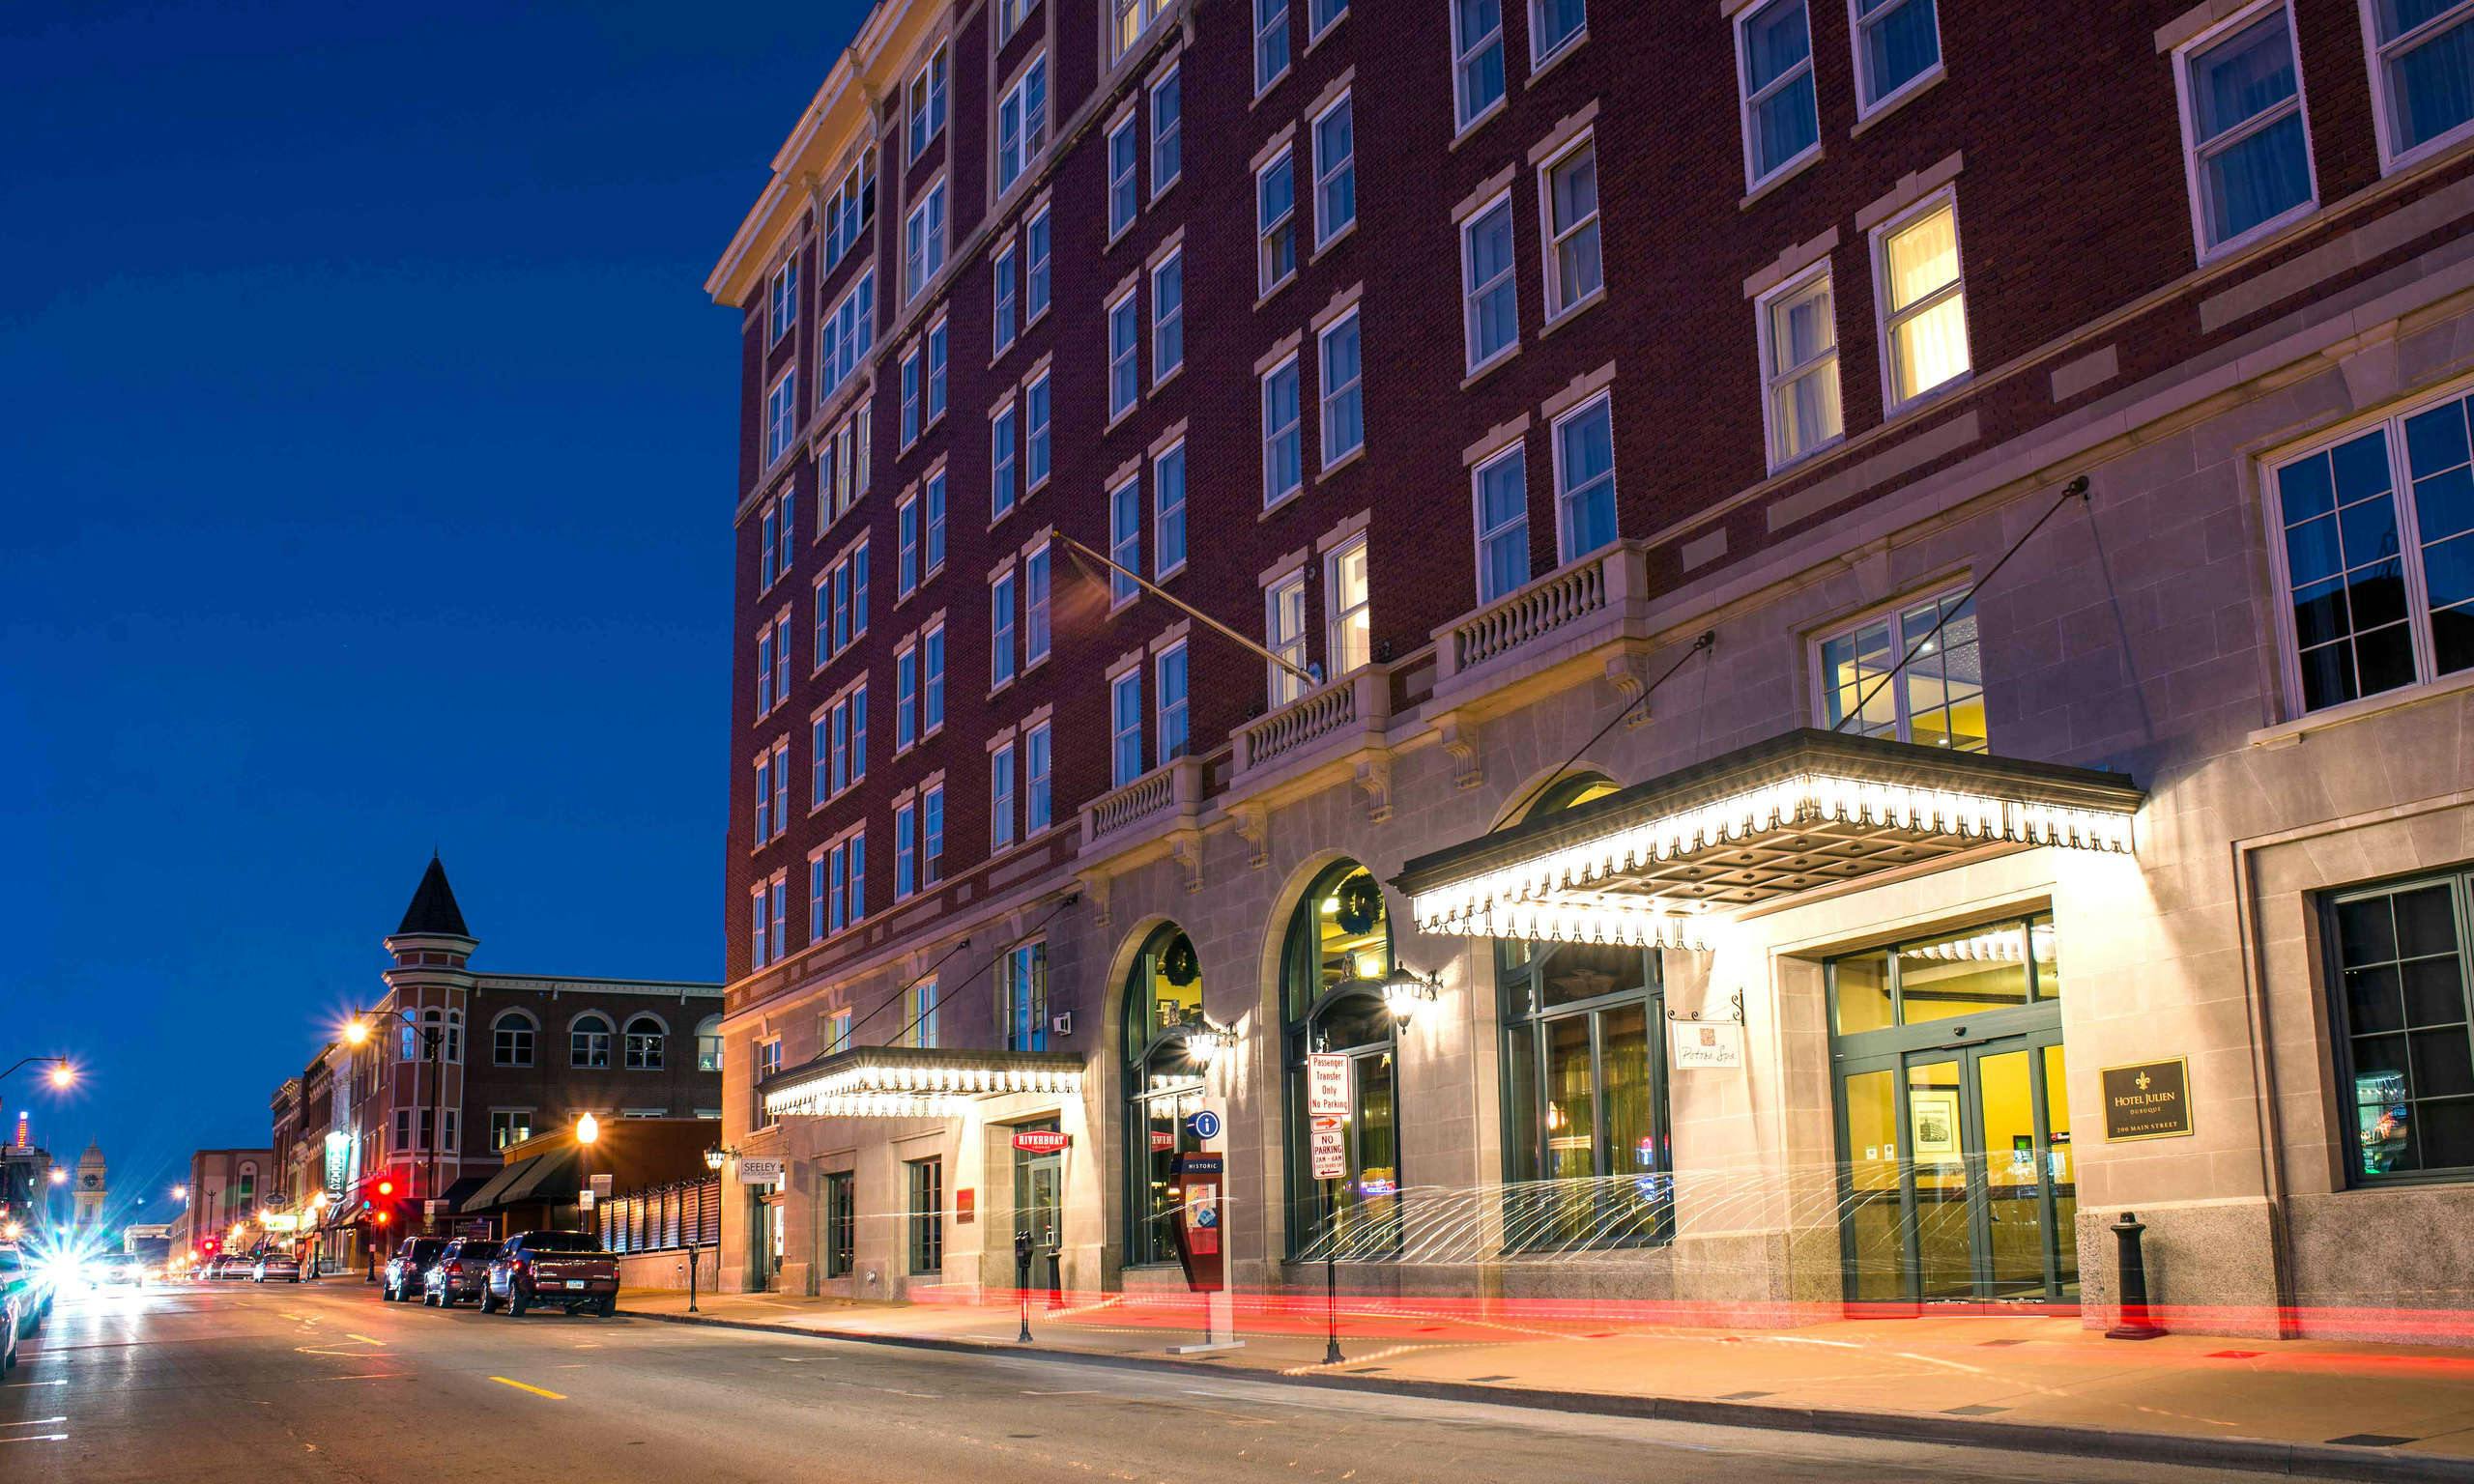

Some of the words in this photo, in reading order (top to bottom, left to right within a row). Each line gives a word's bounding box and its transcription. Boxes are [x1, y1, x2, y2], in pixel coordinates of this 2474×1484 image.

[1313, 1057, 1343, 1070] Passenger
[1316, 1071, 1341, 1081] Transfer
[1322, 1085, 1337, 1097] Only
[2114, 1096, 2144, 1107] HOTEL
[2145, 1092, 2174, 1105] JULIEN
[1312, 1099, 1321, 1109] No
[1323, 1099, 1348, 1111] Parking
[1019, 1135, 1064, 1145] RIVERBOAT
[1321, 1135, 1334, 1145] NO
[1314, 1145, 1342, 1155] PARKING
[744, 1162, 776, 1172] SEELEY
